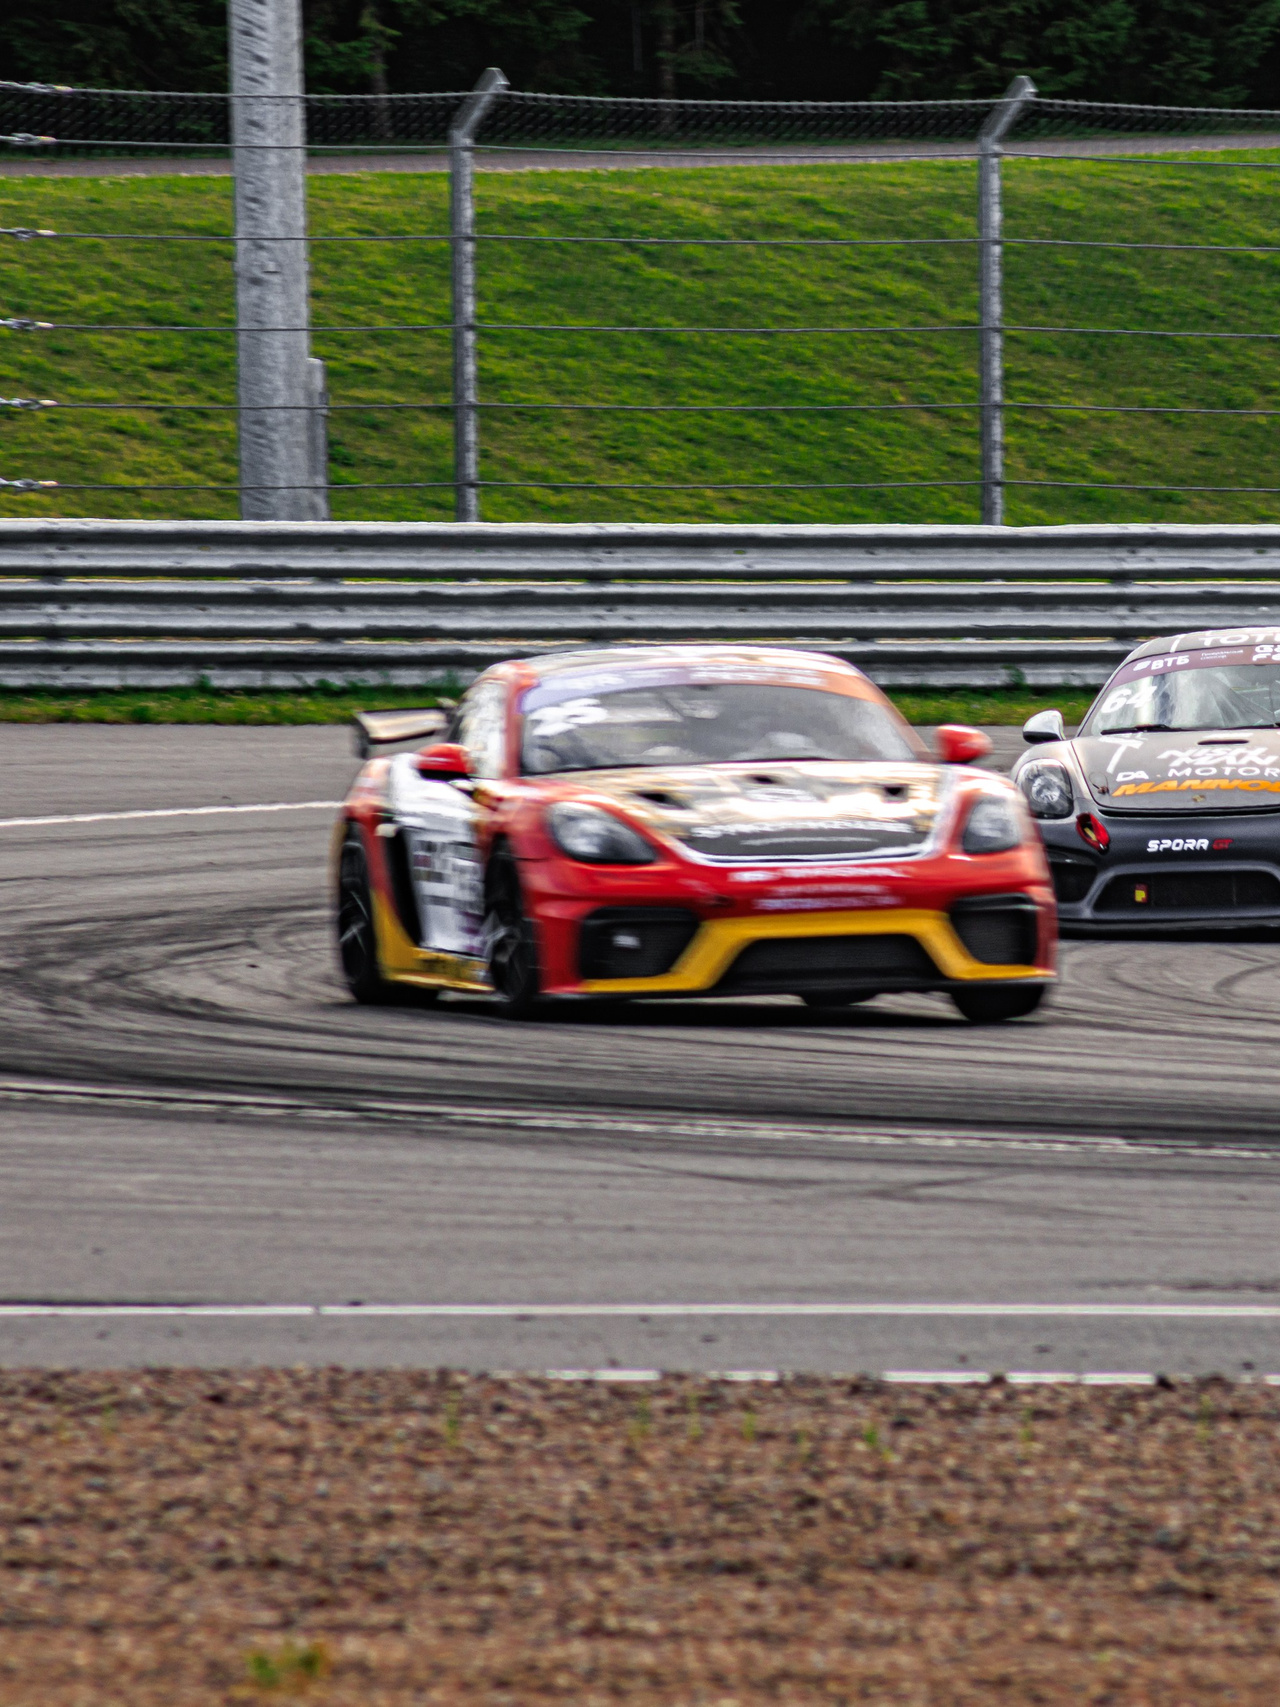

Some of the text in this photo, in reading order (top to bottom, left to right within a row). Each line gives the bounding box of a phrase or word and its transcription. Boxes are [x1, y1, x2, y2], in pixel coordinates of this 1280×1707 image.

[1100, 686, 1158, 714] 64
[1146, 837, 1234, 853] SPORA GT
